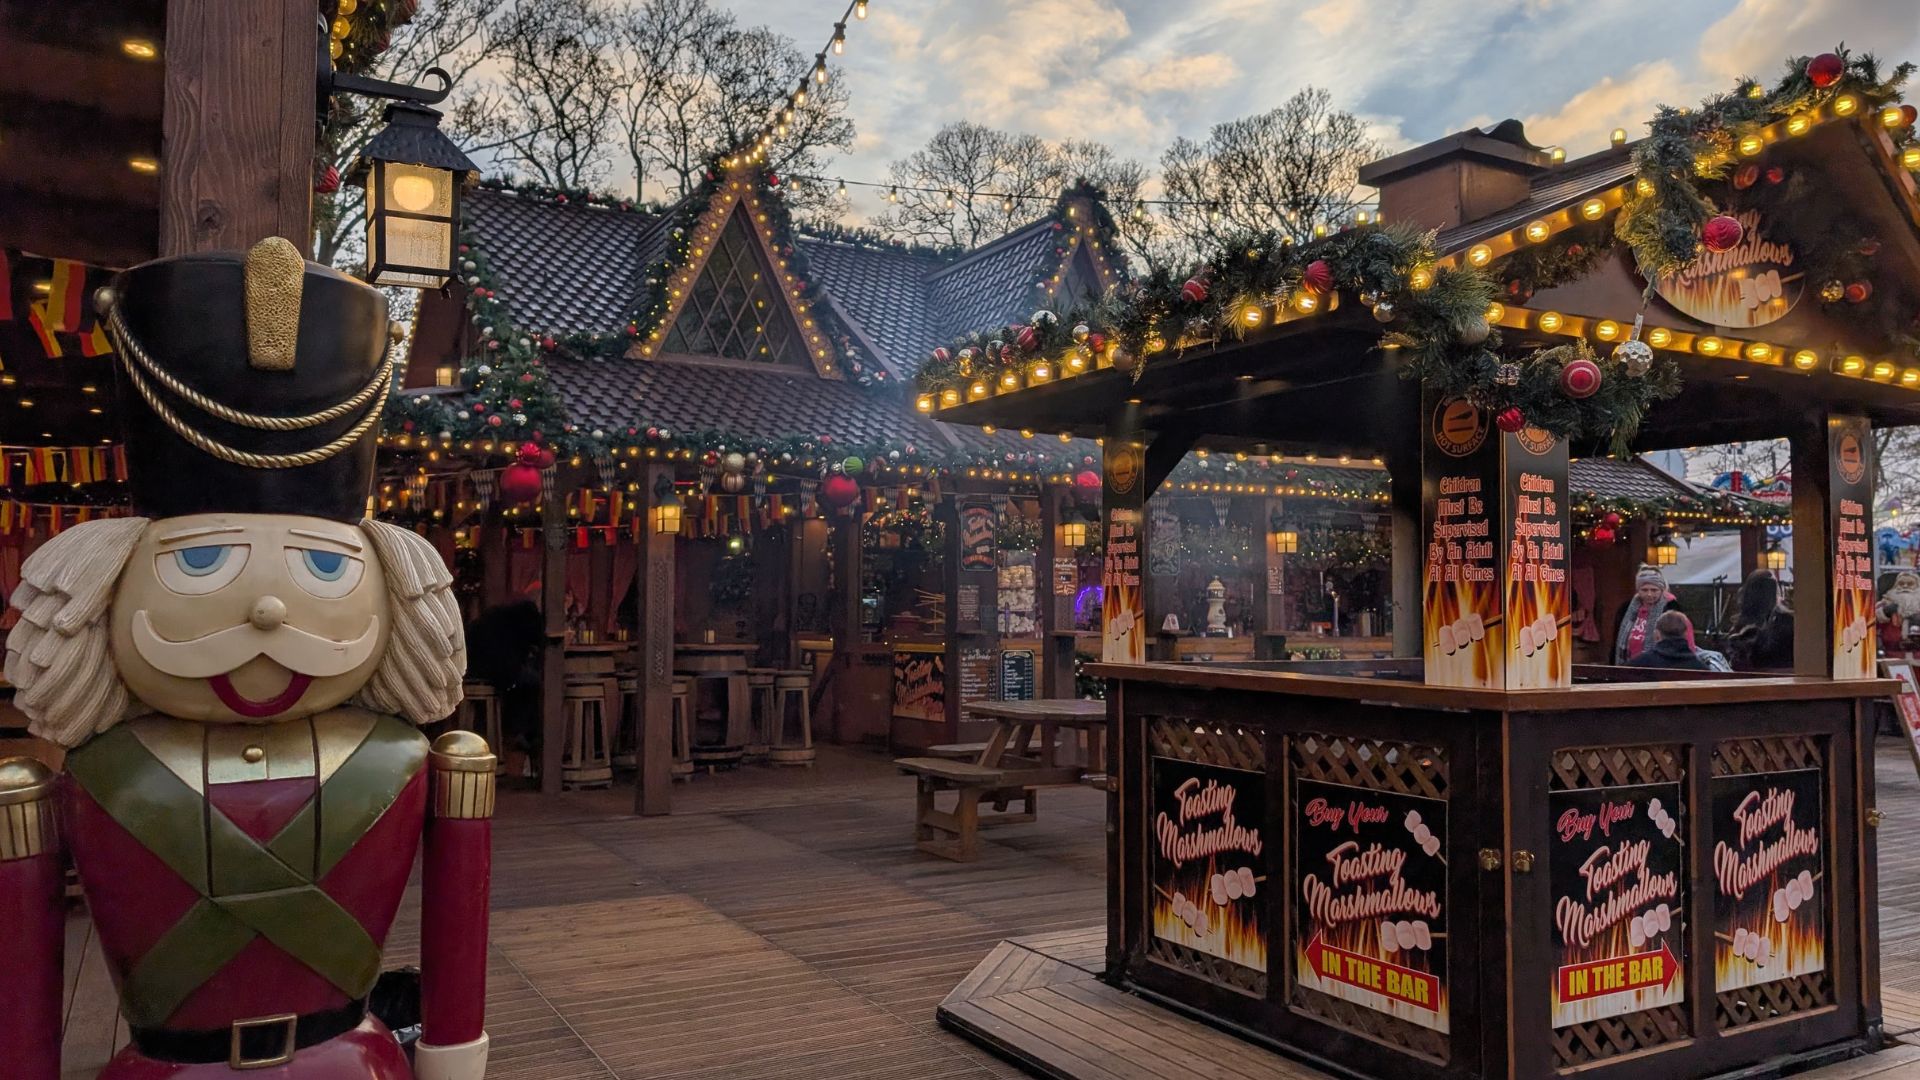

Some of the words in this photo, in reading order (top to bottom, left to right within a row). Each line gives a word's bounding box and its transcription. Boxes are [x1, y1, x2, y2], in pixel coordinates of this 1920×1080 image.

[1436, 431, 1452, 450] HOT
[1440, 476, 1481, 494] Children
[1520, 472, 1554, 493] Children
[1438, 498, 1465, 516] Must
[1468, 496, 1483, 514] Be
[1518, 495, 1542, 514] Must
[1543, 496, 1556, 515] Be
[1433, 518, 1489, 541] Supervised
[1515, 517, 1560, 540] Supervised
[1429, 542, 1443, 563] By
[1447, 541, 1462, 560] An
[1466, 541, 1493, 559] Adult
[1511, 540, 1524, 562] By
[1526, 541, 1539, 559] An
[1542, 541, 1564, 560] Adult
[1429, 564, 1440, 581] At
[1445, 564, 1459, 581] All
[1462, 563, 1494, 581] Times
[1511, 563, 1522, 581] At
[1525, 563, 1538, 582] All
[1540, 563, 1565, 582] Times
[1174, 777, 1236, 827] Toasting
[1305, 798, 1345, 831] Buy
[1348, 801, 1389, 834] Your
[1733, 787, 1795, 850] Toasting
[1557, 808, 1596, 842] Buy
[1600, 801, 1635, 837] Your
[1157, 811, 1262, 869] Marshmallows
[1326, 841, 1407, 889] Toasting
[1579, 840, 1650, 903] Toasting
[1714, 820, 1819, 899] Marshmallows
[1303, 873, 1441, 928] Marshmallows
[1556, 867, 1678, 947] Marshmallows
[1321, 949, 1341, 973] IN
[1346, 958, 1381, 986] THE
[1386, 968, 1430, 1004] BAR
[1569, 966, 1589, 996] IN
[1592, 962, 1625, 992] THE
[1629, 956, 1664, 985] BAR
